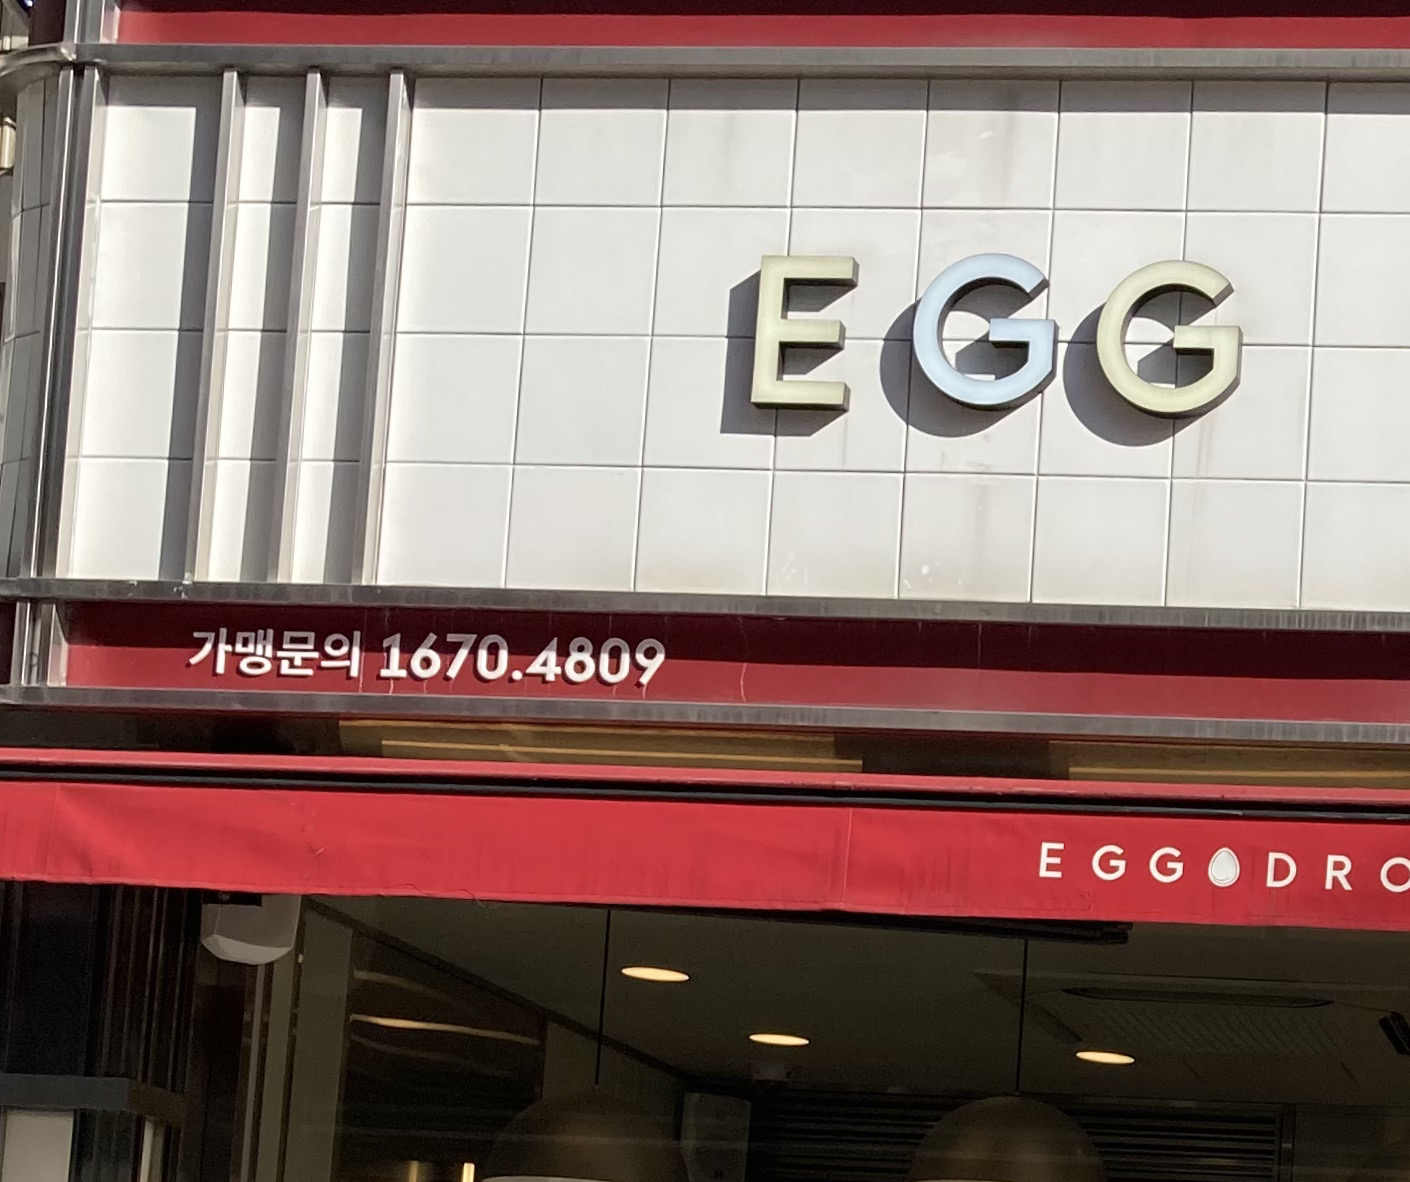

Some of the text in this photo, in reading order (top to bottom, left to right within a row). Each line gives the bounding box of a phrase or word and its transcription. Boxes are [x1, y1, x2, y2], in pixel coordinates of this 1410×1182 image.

[751, 253, 1243, 419] EGG
[188, 627, 666, 688] 가맹문의 1670.4809
[1038, 841, 1185, 884] EGG
